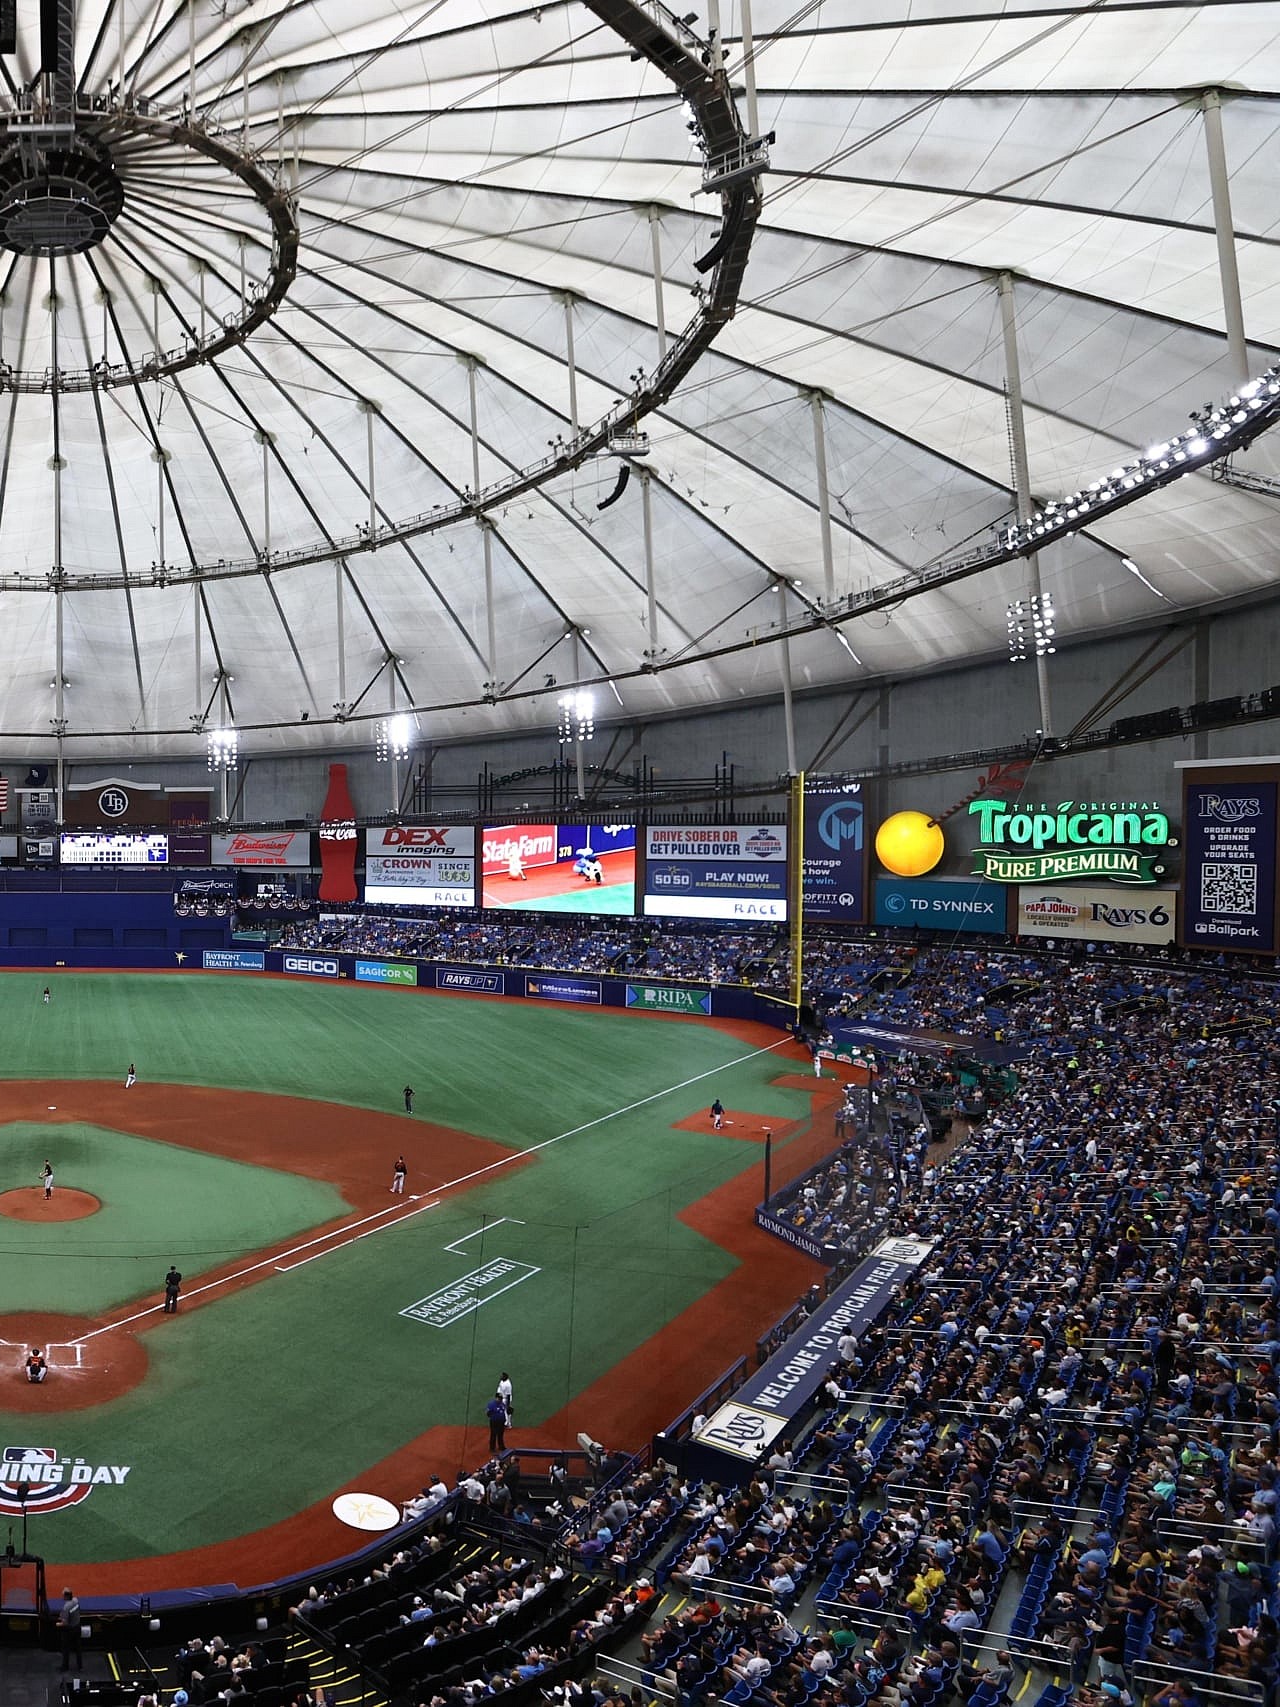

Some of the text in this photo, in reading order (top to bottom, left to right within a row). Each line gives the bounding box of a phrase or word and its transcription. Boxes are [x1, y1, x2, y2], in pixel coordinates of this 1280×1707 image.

[104, 794, 123, 811] TB
[1080, 802, 1160, 811] ORIGINAL
[1198, 794, 1260, 822] RAYS
[968, 800, 1169, 849] Tropicana
[382, 828, 450, 846] DEX
[653, 831, 738, 842] DRIVE SOBER OR
[234, 840, 288, 850] Budweiser
[397, 846, 456, 854] imaging
[650, 843, 740, 856] GET PULLED OVER
[383, 859, 431, 869] CROWN
[986, 853, 1138, 878] PURE PREMIUM
[706, 872, 769, 883] PLAY NOW!
[435, 893, 468, 901] RACE
[734, 904, 776, 915] RACE
[910, 899, 994, 914] TD SYNNEX
[1026, 903, 1046, 912] PAPA
[1090, 903, 1170, 927] RAYS 6
[1208, 924, 1260, 936] Ballpark
[286, 958, 337, 973] GEICO
[358, 966, 401, 978] SAGICOR
[658, 990, 694, 1005] RIPA
[758, 1214, 821, 1257] RAYMOND JAMES
[410, 1262, 516, 1319] BAYFRONT HEALTH
[440, 1297, 481, 1320] Petersburg
[752, 1260, 900, 1408] WELCOME TO TROPICANA FIELD
[705, 1412, 766, 1448] RAYS
[71, 1465, 130, 1484] DAY
